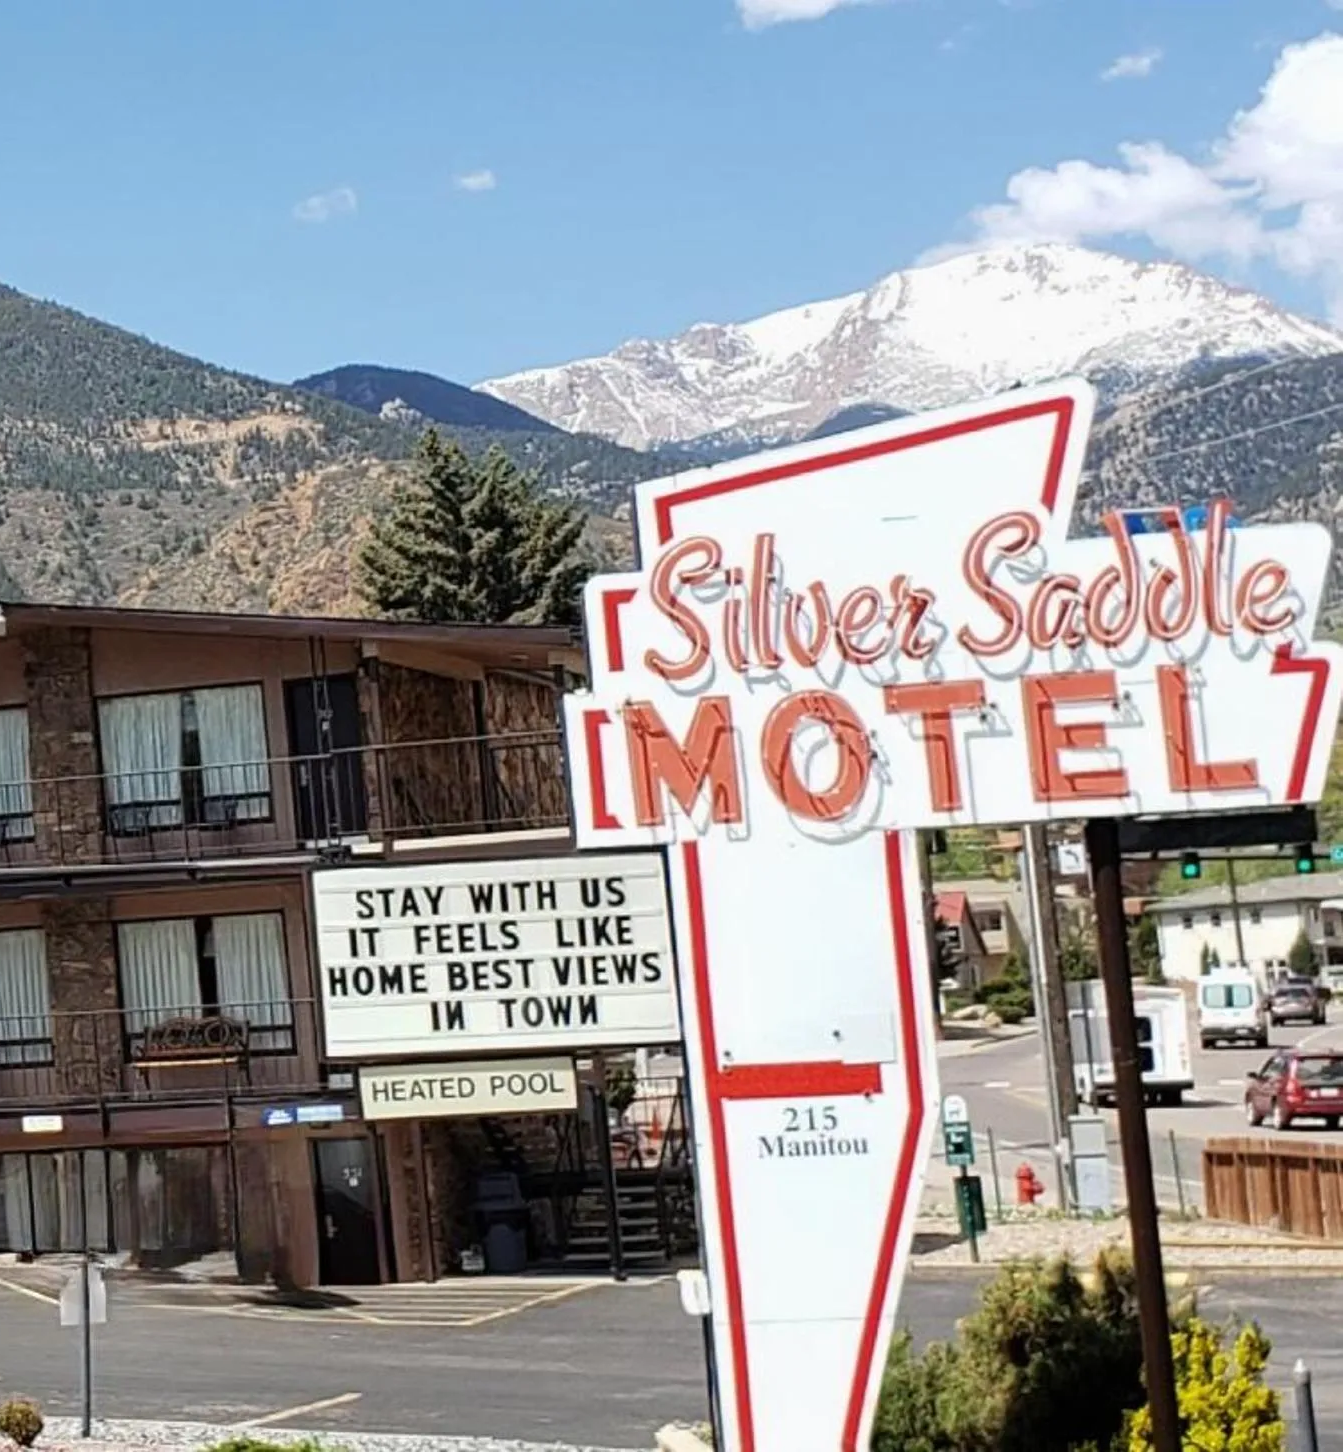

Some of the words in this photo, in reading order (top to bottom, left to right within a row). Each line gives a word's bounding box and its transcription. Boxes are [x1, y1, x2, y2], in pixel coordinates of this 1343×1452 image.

[644, 532, 937, 681] Silver
[959, 498, 1296, 657] Saddle
[622, 663, 1258, 826] MOTEL
[356, 886, 445, 919] STAY
[468, 880, 557, 914] WITH
[579, 876, 627, 908] US
[349, 927, 381, 958] IT
[413, 920, 520, 955] FEELS
[556, 915, 634, 948] LIKE
[328, 964, 429, 997] HOME
[447, 958, 535, 992] BEST
[551, 952, 662, 986] VIEWS
[430, 1000, 466, 1031] IN
[498, 994, 599, 1028] TOWN
[371, 1076, 475, 1102] HEATED
[489, 1072, 565, 1097] POOL
[782, 1105, 839, 1132] 215
[758, 1133, 870, 1159] Manitou
